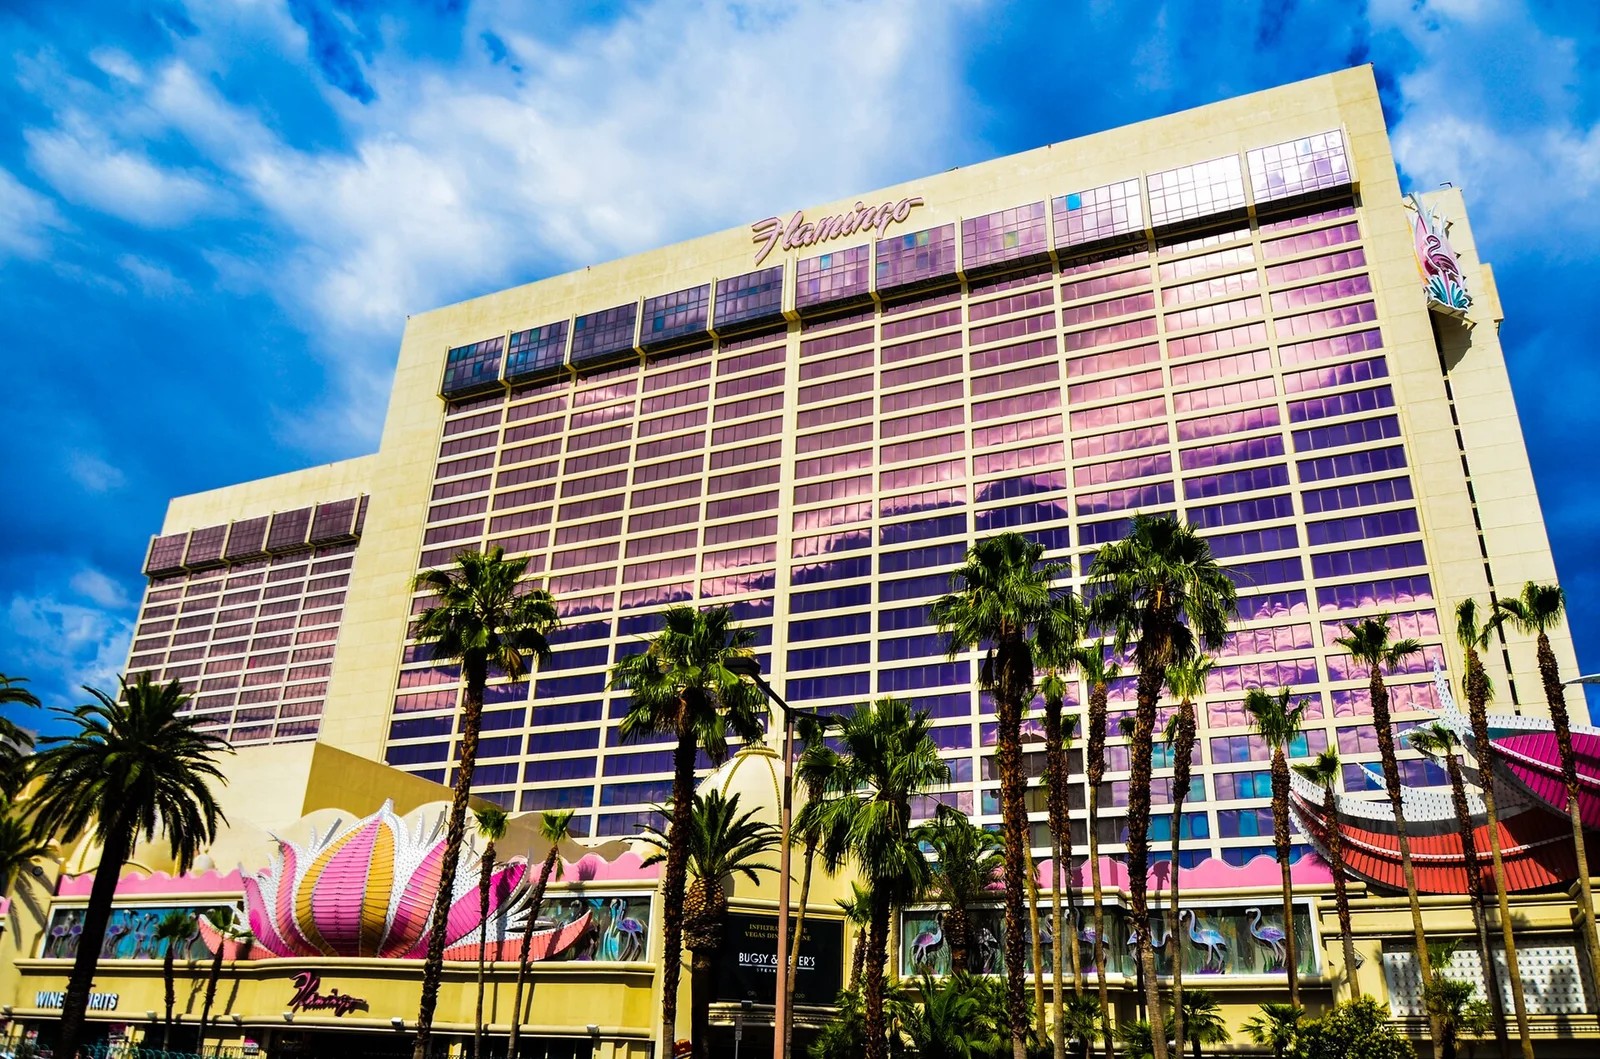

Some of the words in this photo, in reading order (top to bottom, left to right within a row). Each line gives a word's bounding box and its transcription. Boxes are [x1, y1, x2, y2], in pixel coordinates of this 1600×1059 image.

[751, 196, 924, 266] Flamingo
[749, 923, 793, 932] INFILTRAG
[739, 952, 769, 964] BUGSY
[784, 955, 816, 967] EER'S
[36, 991, 66, 1009] WINE
[83, 993, 118, 1011] IRITS
[288, 972, 369, 1017] Flamingo
